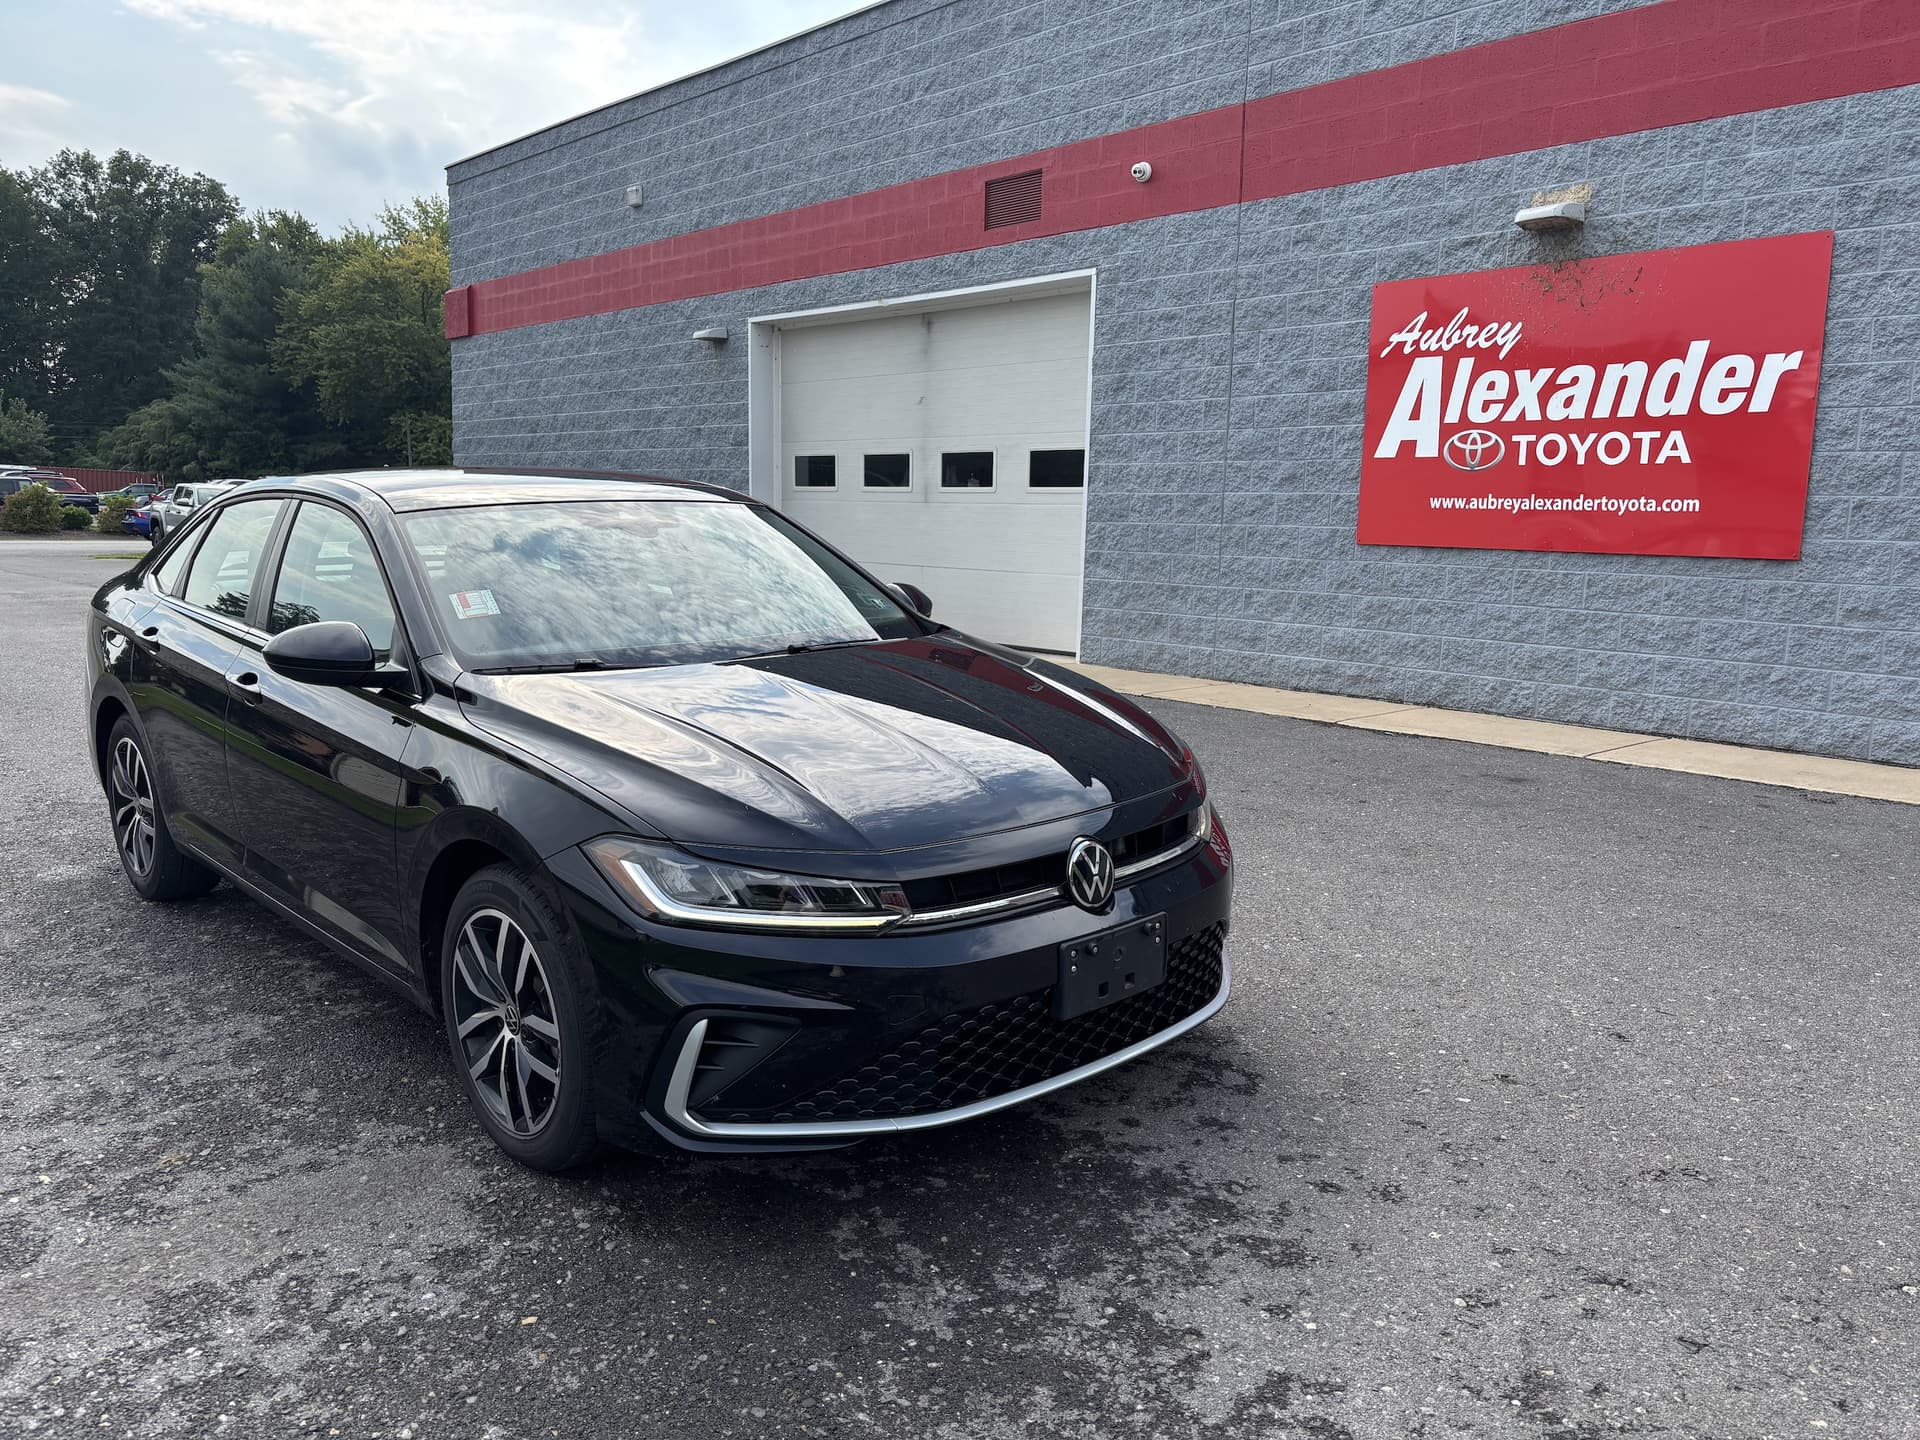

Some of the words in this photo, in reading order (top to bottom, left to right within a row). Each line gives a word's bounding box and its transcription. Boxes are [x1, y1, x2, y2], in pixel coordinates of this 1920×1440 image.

[1380, 306, 1523, 361] Aubrey
[1373, 339, 1804, 459] Alexander
[1511, 430, 1692, 467] TOYOTA
[1429, 493, 1700, 514] www.aubreyalexandertoyota.com
